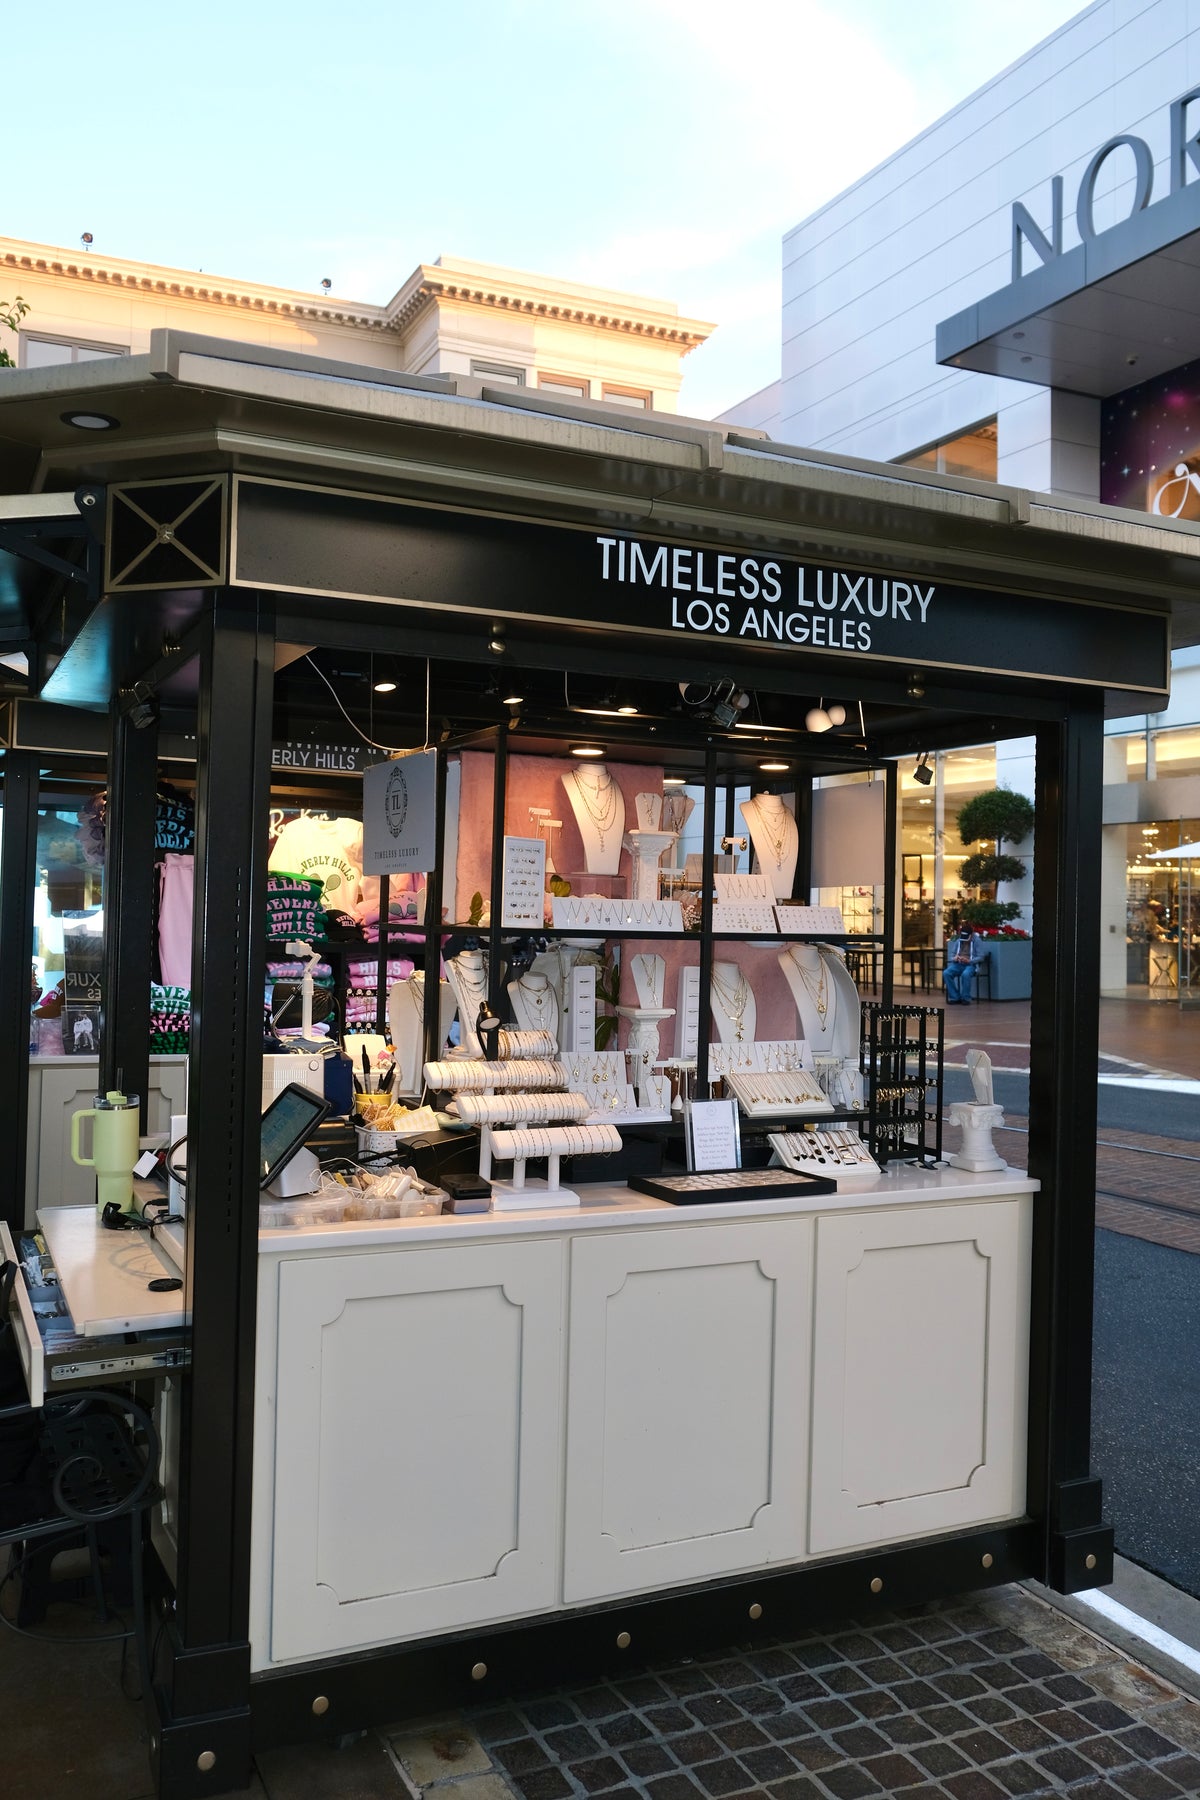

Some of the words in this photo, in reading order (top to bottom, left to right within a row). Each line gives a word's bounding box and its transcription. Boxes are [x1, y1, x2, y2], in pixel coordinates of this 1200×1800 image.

[597, 536, 782, 603] TIMELESS
[798, 566, 936, 623] LUXURY
[672, 596, 730, 634] LOS
[739, 606, 872, 651] ANGELES
[315, 753, 356, 771] HILLS
